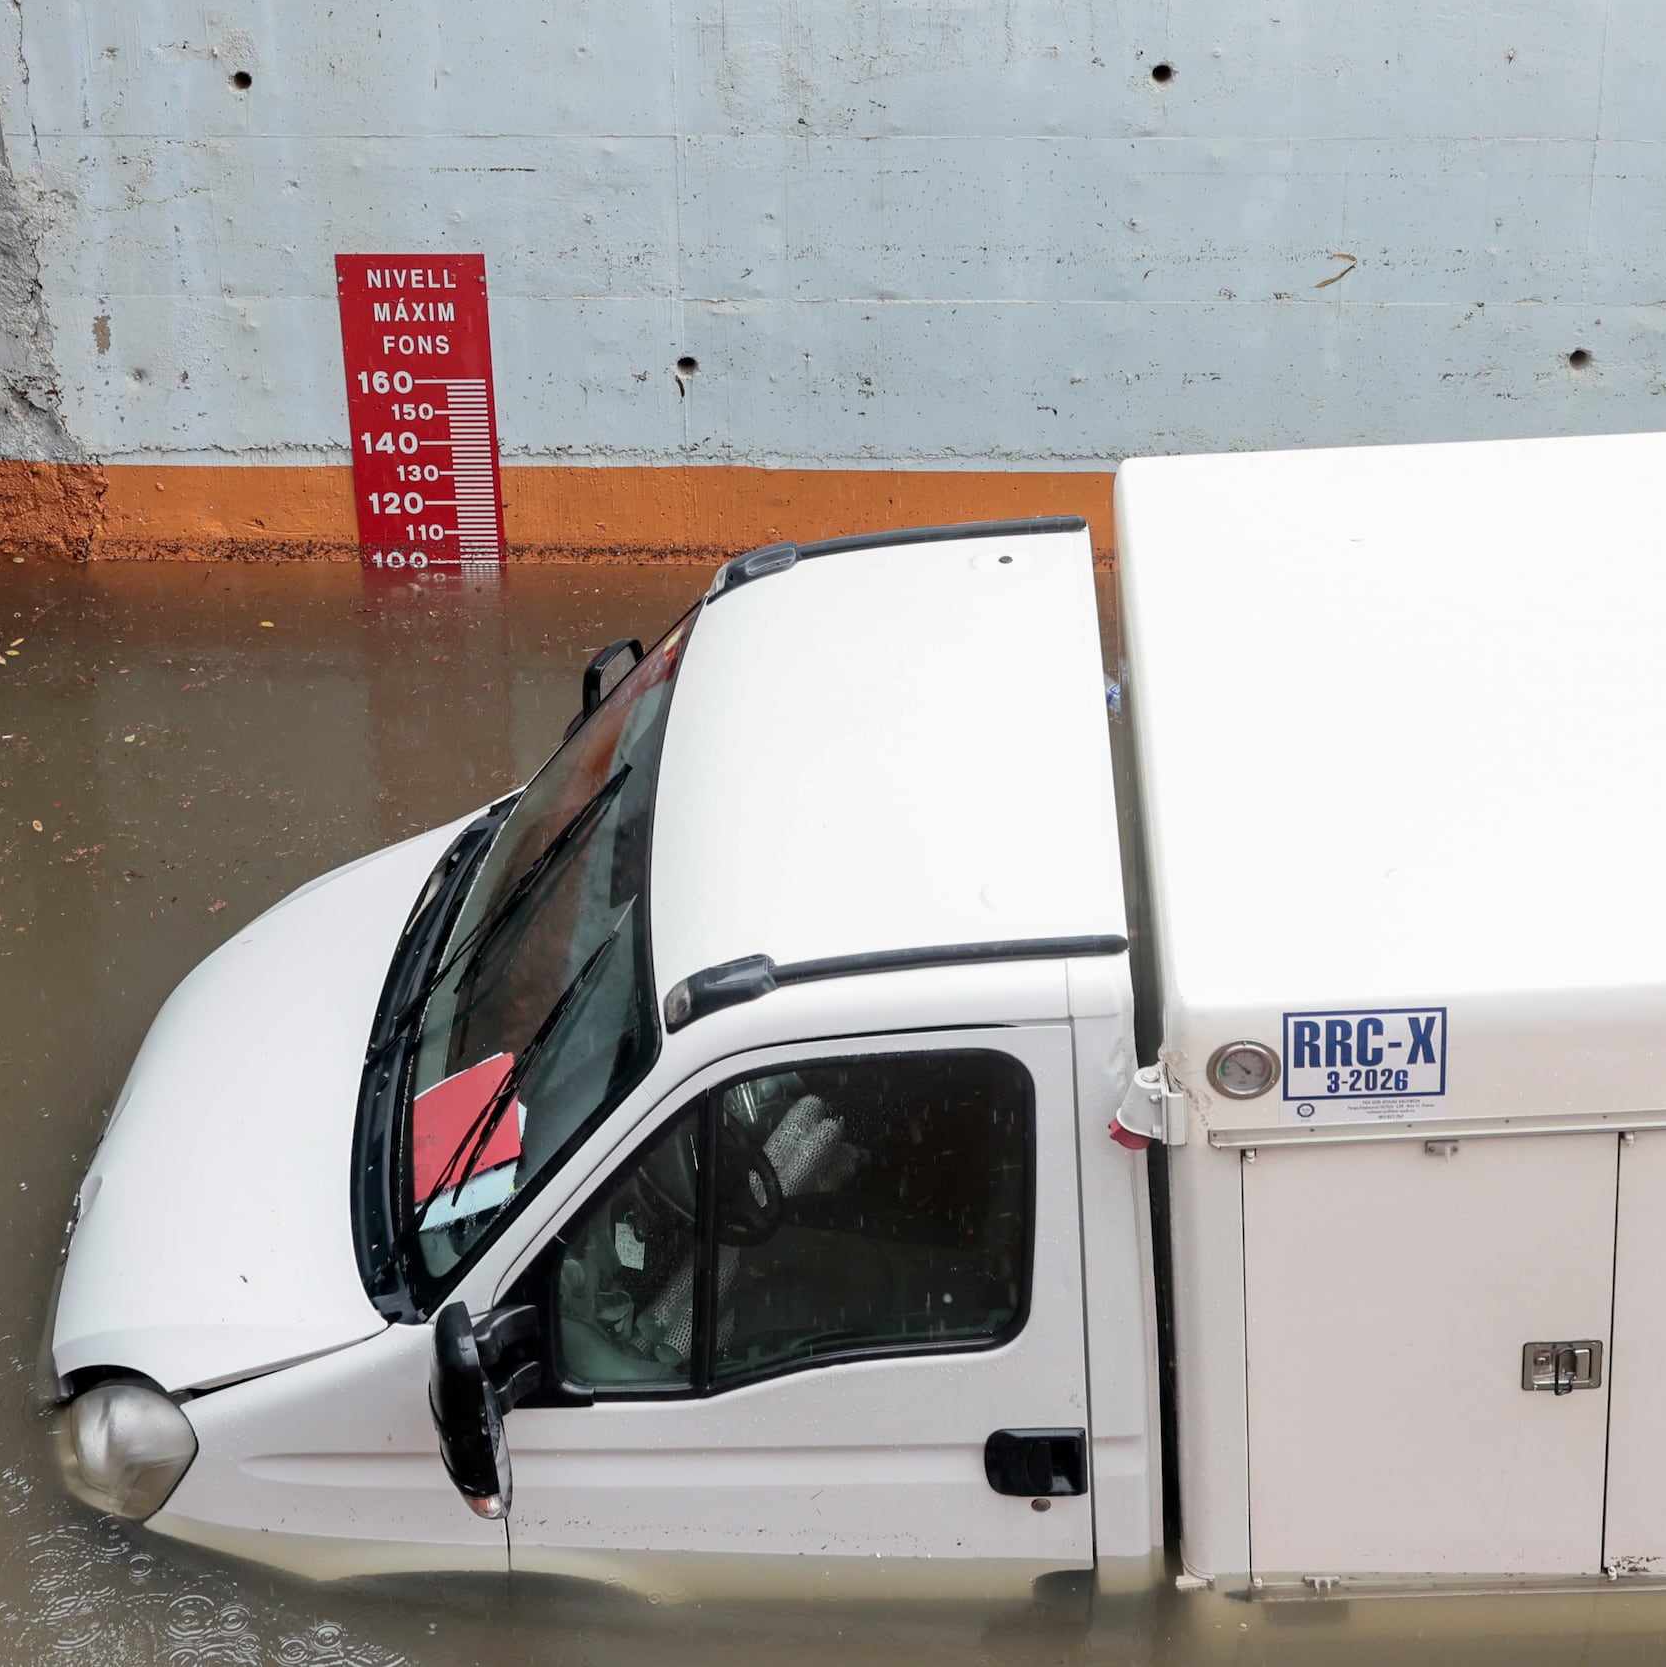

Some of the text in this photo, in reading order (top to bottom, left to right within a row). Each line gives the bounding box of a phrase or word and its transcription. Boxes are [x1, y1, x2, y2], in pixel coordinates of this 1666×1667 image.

[366, 268, 457, 289] NIVELL
[373, 297, 455, 322] MÁXIM
[383, 335, 450, 355] FONS
[357, 370, 413, 394] 160
[391, 402, 434, 421] 150
[360, 431, 419, 455] 140
[396, 464, 439, 482] 130
[368, 491, 424, 515] 120
[405, 524, 444, 541] 110
[372, 551, 429, 569] 100
[1293, 1016, 1436, 1069] RRC-X
[1326, 1068, 1409, 1094] 3-2026
